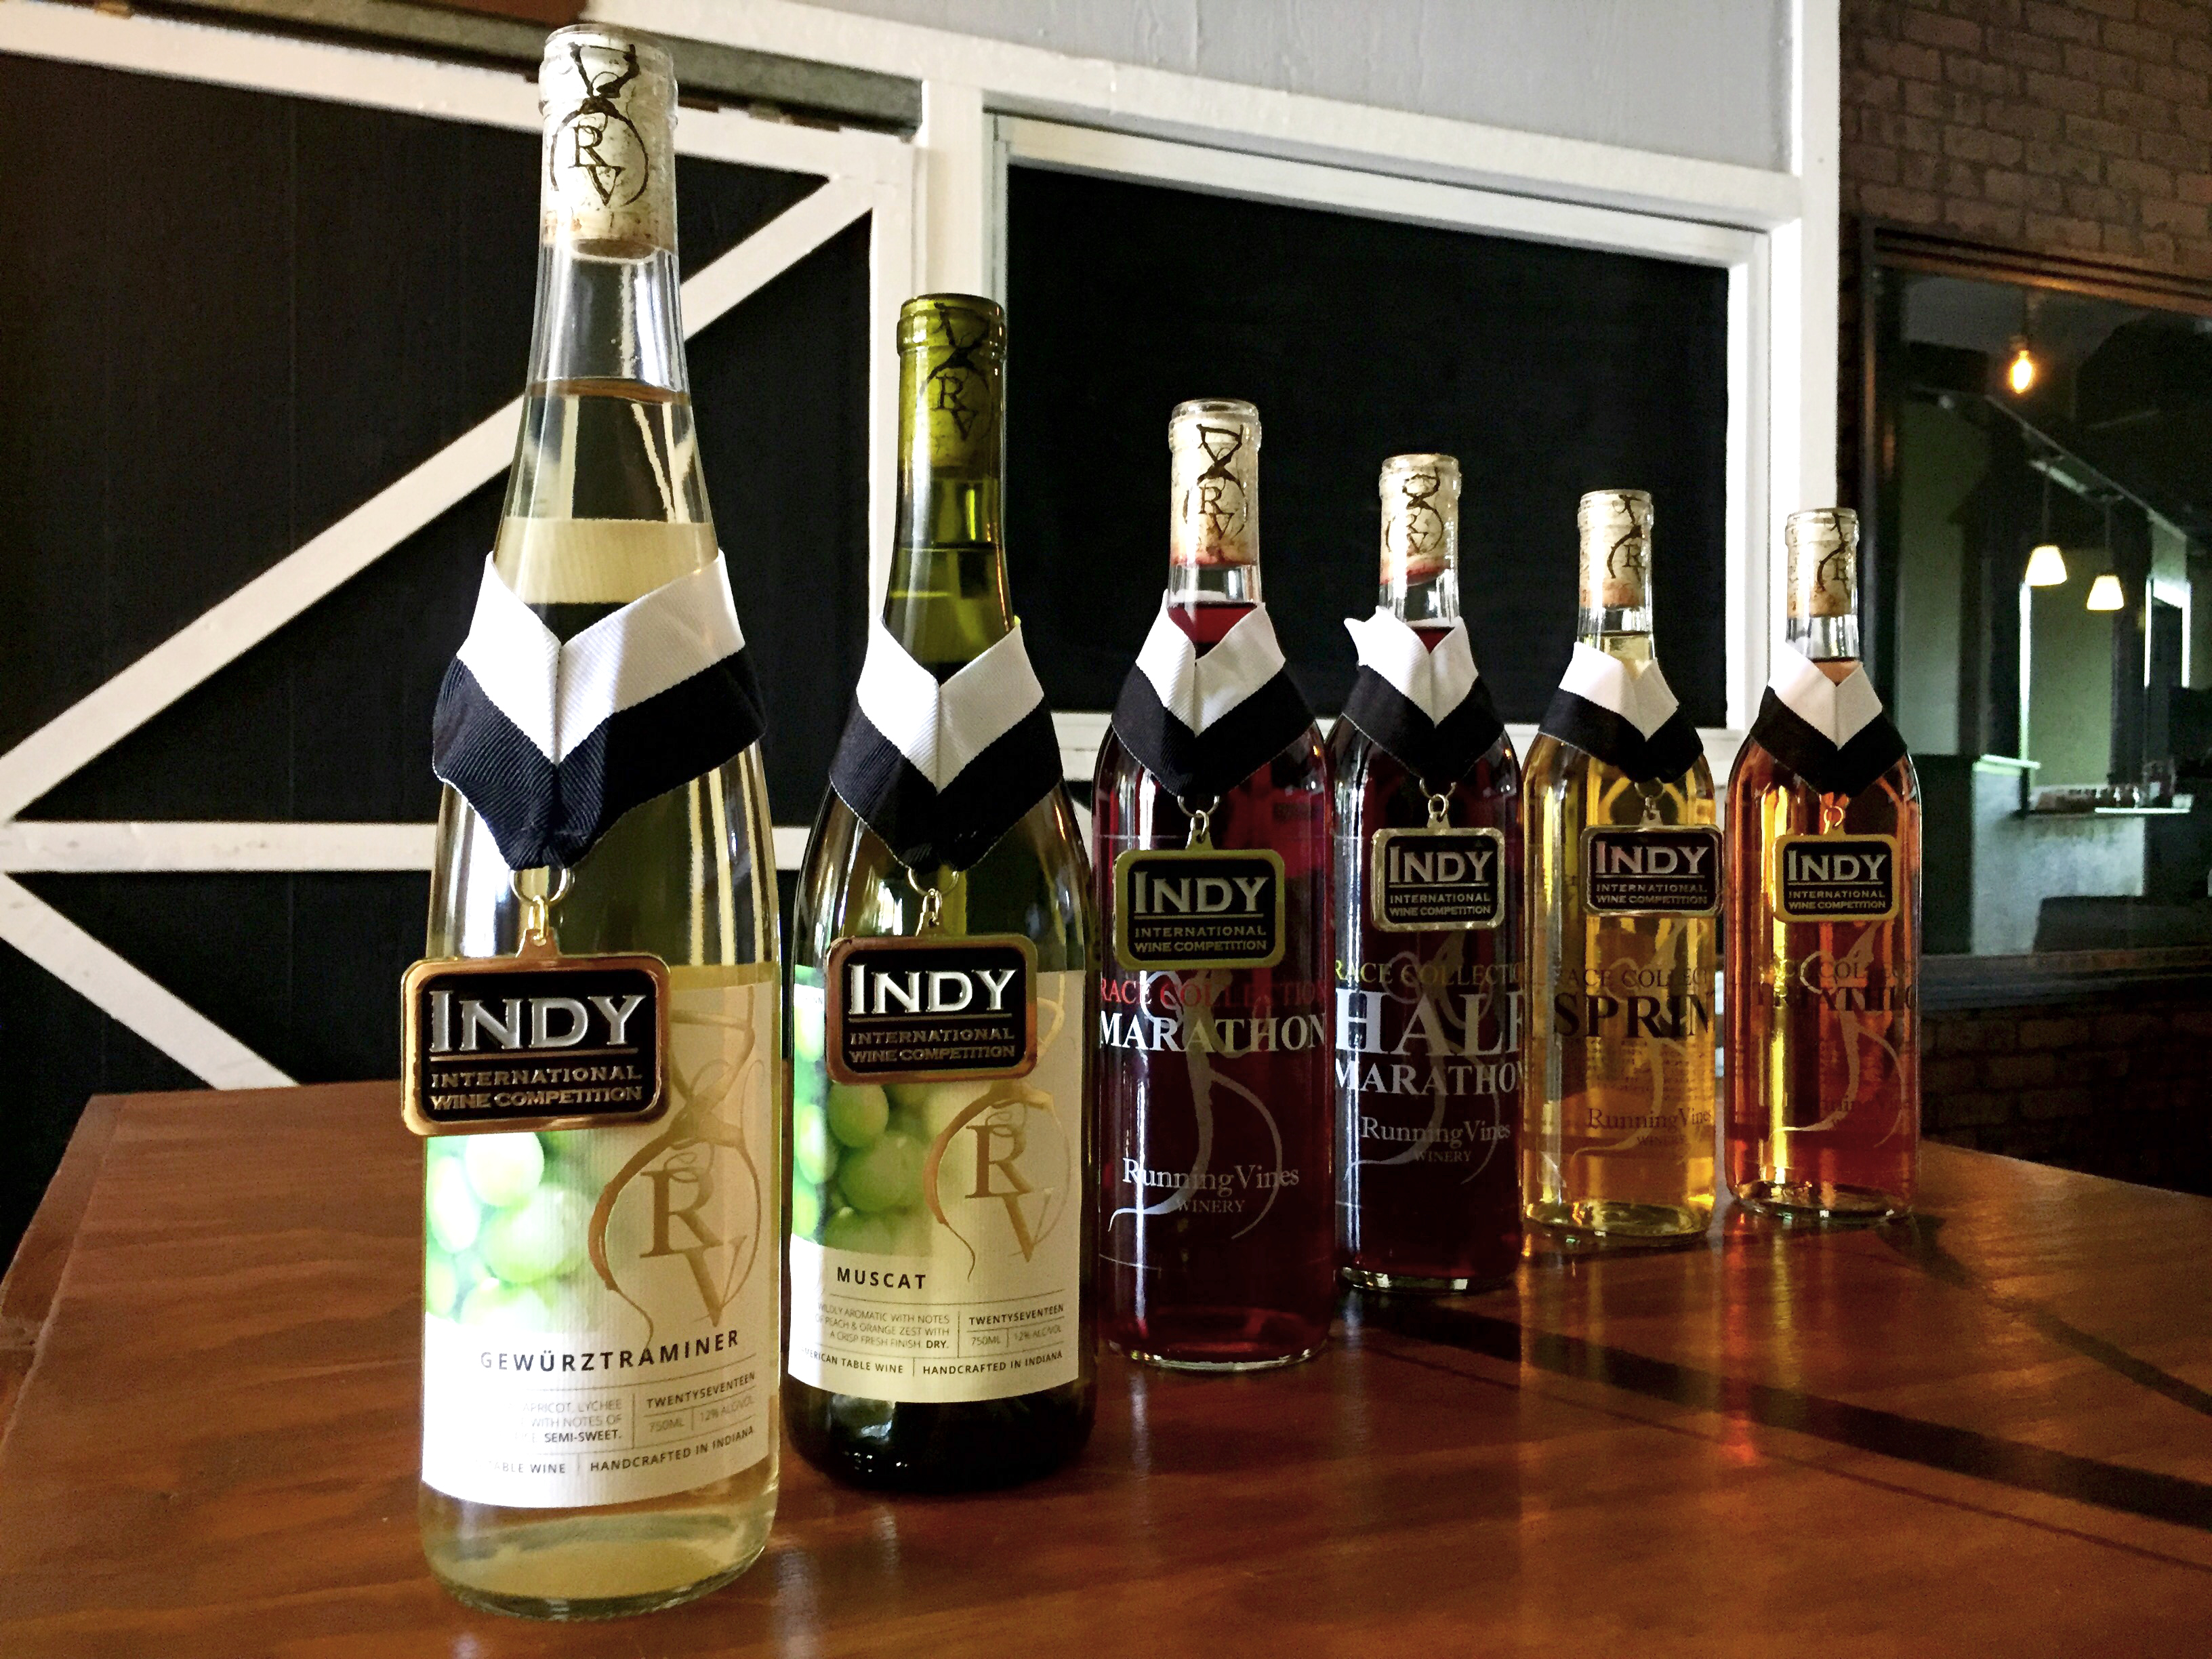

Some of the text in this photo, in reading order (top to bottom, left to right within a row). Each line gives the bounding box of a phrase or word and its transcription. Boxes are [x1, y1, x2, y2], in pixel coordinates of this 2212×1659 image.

[1389, 846, 1494, 884] INDY
[1595, 840, 1710, 875] INDY
[1787, 849, 1888, 882] INDY
[1133, 871, 1270, 914] INDY
[1596, 883, 1708, 893] INTERNATIONAL
[1788, 890, 1885, 899] INTERNATIONAL
[1389, 893, 1491, 904] INTERNATIONAL
[1596, 895, 1708, 905] WINE COMPETITION
[1788, 899, 1886, 910] WINE COMPETITION
[1389, 905, 1491, 918] WINE COMPETITION
[1134, 926, 1267, 939] INTERNATIONAL
[1134, 939, 1268, 954] WINE COMPETITION
[847, 962, 1018, 1015] INDY
[428, 989, 647, 1053] INDY
[851, 1027, 1015, 1046] INTERNATIONAL
[1100, 1010, 1326, 1053] MARATHON
[848, 1044, 1015, 1063] WINE COMPETITION
[431, 1065, 643, 1088] INTERNATIONAL
[430, 1085, 643, 1111] WINE COMPETITION
[1176, 1198, 1246, 1214] WINERY
[836, 1266, 927, 1289] MUSCAT
[844, 1309, 887, 1322] AROMATIC
[890, 1313, 914, 1322] WITH
[918, 1313, 950, 1324] NOTES
[969, 1303, 1064, 1326] TWENTYSEVENTEEN
[859, 1322, 896, 1336] ORANGE
[899, 1326, 922, 1336] ZEST
[925, 1328, 949, 1336] WITH
[480, 1328, 739, 1372] GEWÜRZTRAMINER
[861, 1335, 888, 1347] FRESH
[926, 1340, 950, 1349] DRY.
[841, 1357, 872, 1371] TABLE
[875, 1362, 904, 1374] WINE
[923, 1349, 1063, 1375] HANDCRAFTED IN INDIANA
[646, 1370, 756, 1410] TWENTYSEVENTEEN
[577, 1398, 622, 1414] LYCHEE
[563, 1415, 602, 1428] NOTES
[606, 1414, 622, 1426] OF
[544, 1428, 623, 1444] SEMI-SWEET.
[590, 1425, 754, 1472] HANDCRAFTED IN INDIANA
[530, 1462, 567, 1475] WINE
